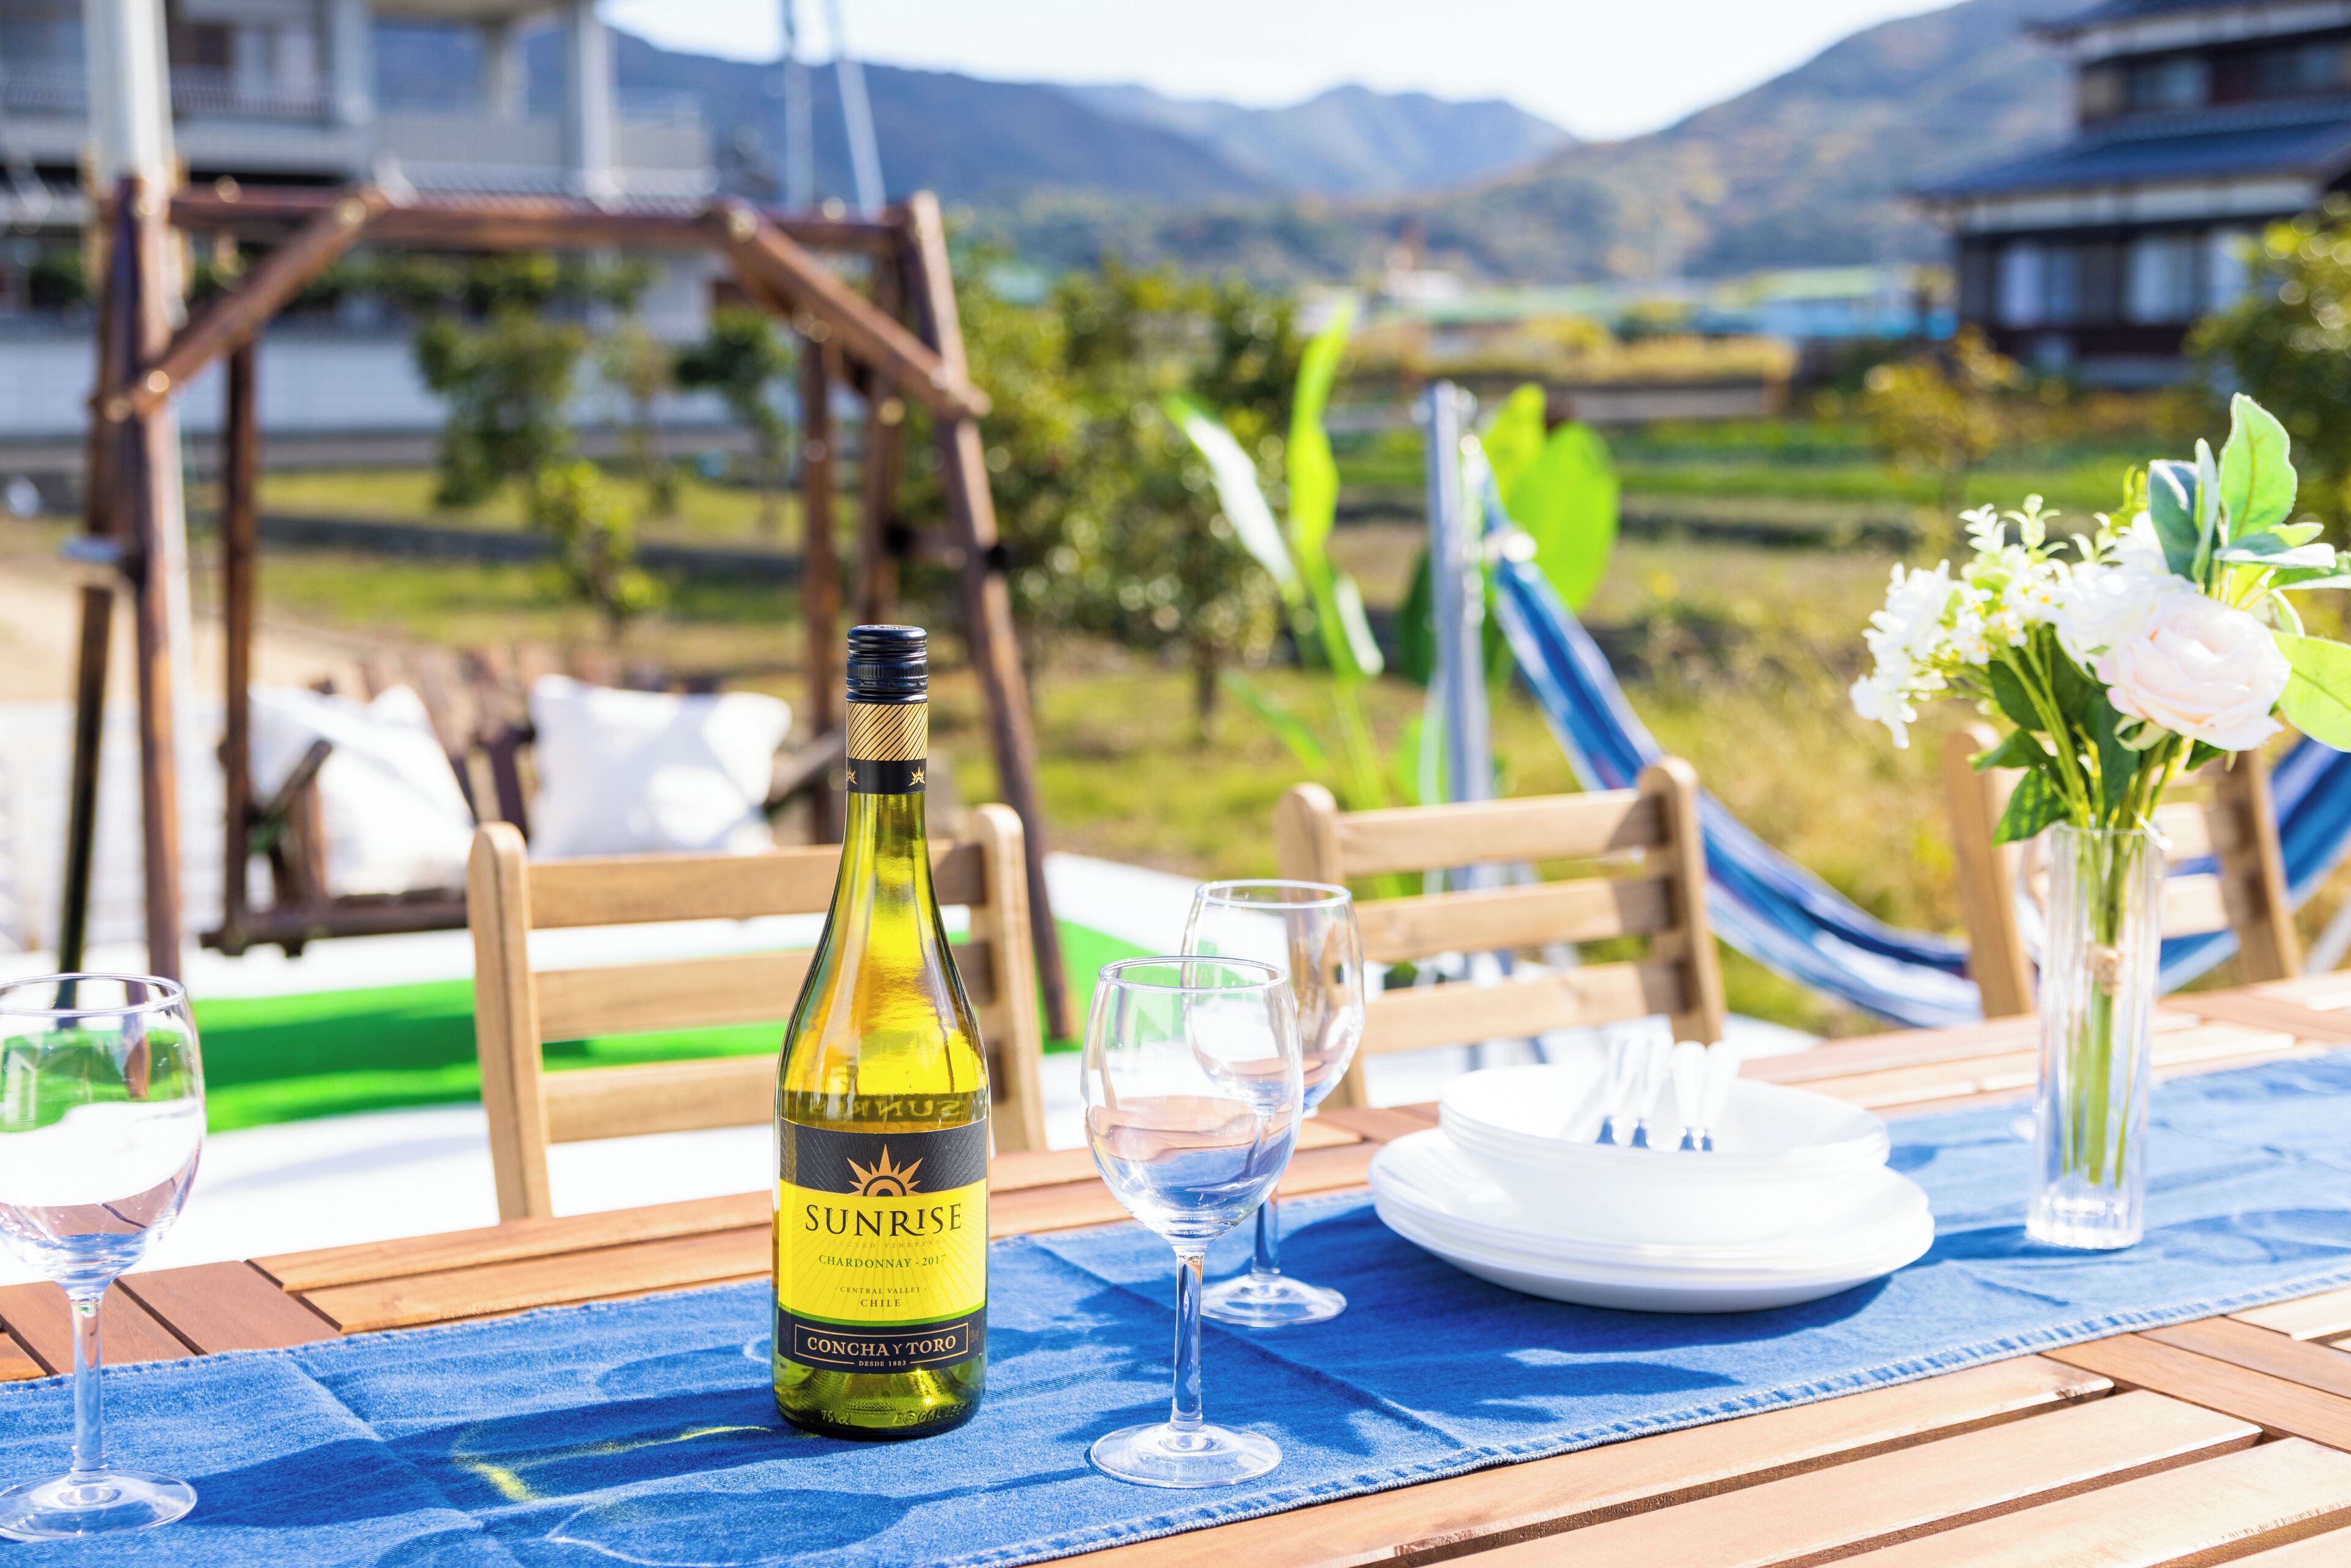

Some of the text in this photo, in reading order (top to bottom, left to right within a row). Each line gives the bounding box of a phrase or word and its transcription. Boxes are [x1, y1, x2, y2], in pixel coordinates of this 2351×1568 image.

[805, 1202, 961, 1237] SUNRISE
[883, 1239, 947, 1249] VINEYARDS
[819, 1255, 946, 1269] CHARDONNAY 2017
[840, 1286, 883, 1295] CENTRAL
[860, 1299, 901, 1308] CHILE
[807, 1337, 890, 1357] CONCHA
[892, 1343, 903, 1355] Y
[906, 1335, 956, 1356] TORO
